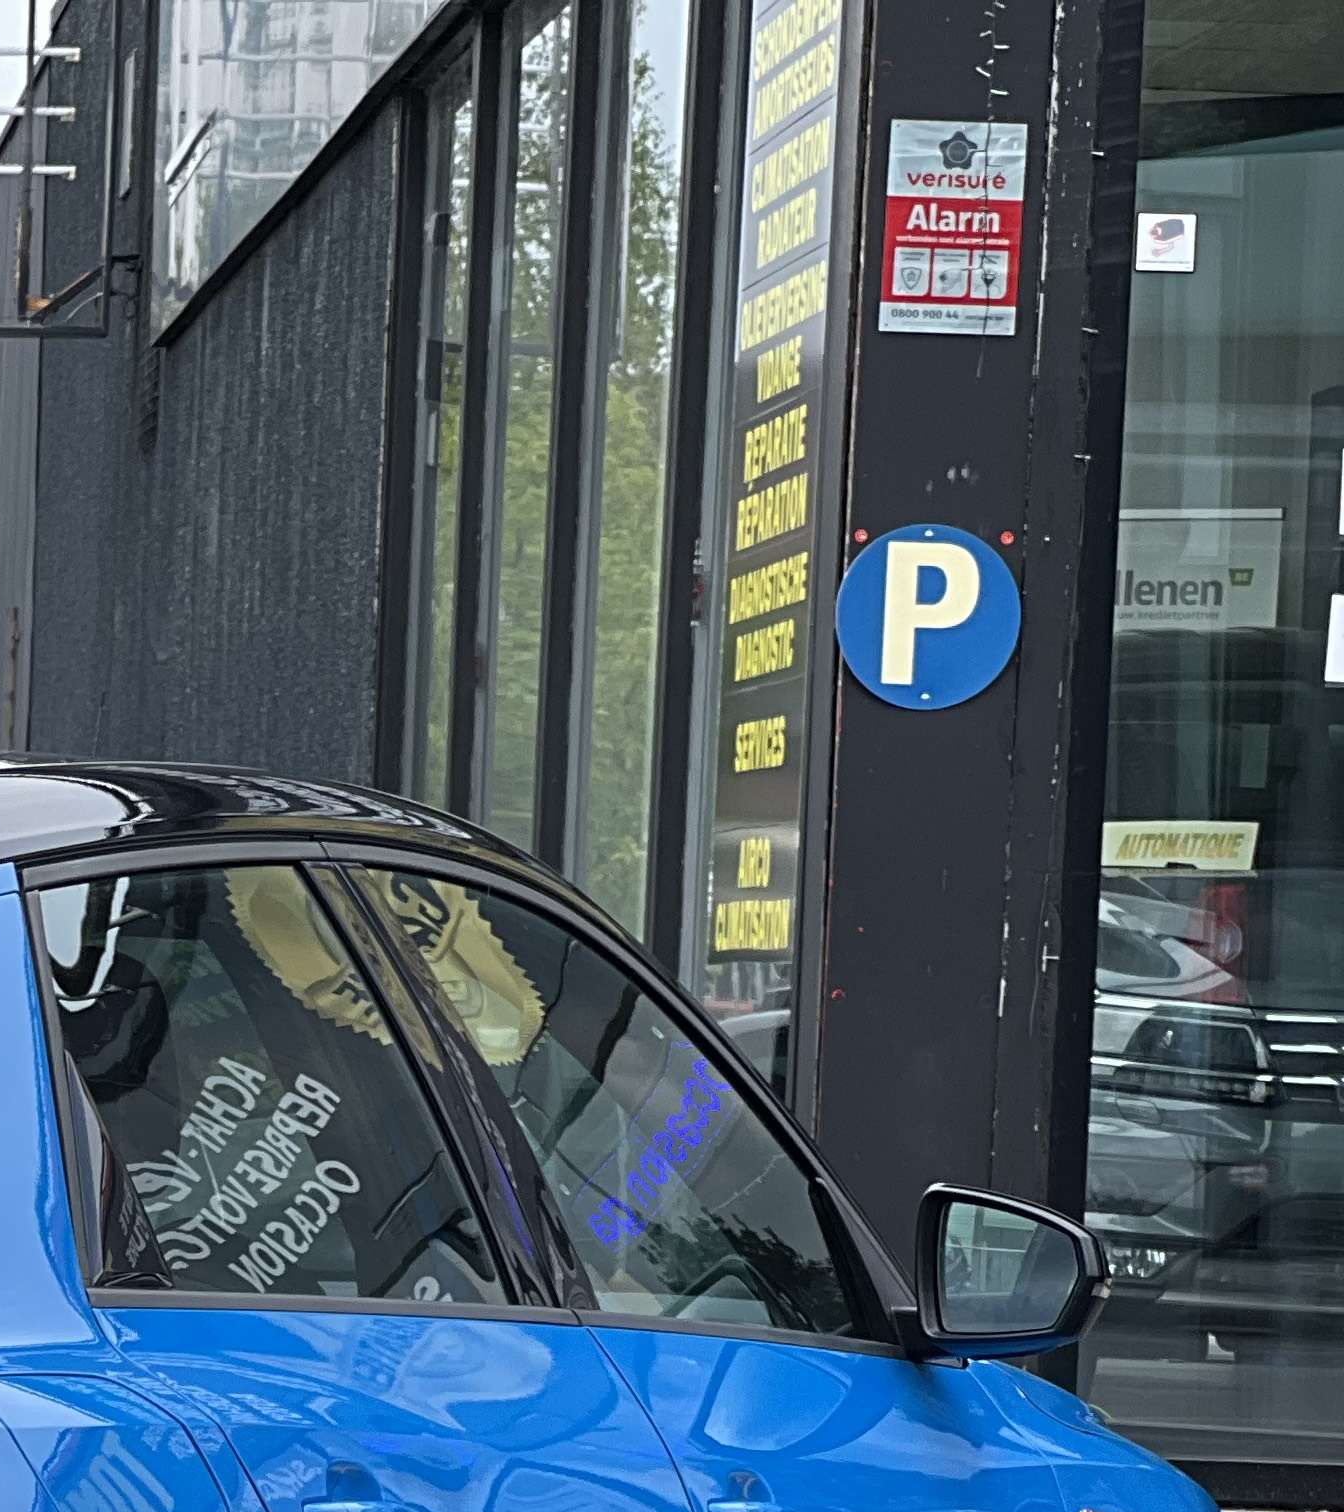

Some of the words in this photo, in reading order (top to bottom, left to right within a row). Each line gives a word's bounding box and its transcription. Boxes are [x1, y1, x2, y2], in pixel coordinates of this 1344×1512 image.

[906, 172, 1006, 190] verisure
[906, 203, 1001, 233] Alarm
[922, 309, 943, 319] 900
[757, 335, 802, 404] VIDANGE
[744, 403, 808, 483] REPARATIE
[736, 473, 808, 551] RÉPARATION
[880, 541, 980, 686] P
[735, 618, 795, 682] DIAGNOSTIC
[735, 715, 786, 773] SERVICES
[737, 837, 771, 889] AIRCO
[1116, 832, 1246, 860] AUTOMATIQUE
[715, 899, 791, 952] CLIMATISATION
